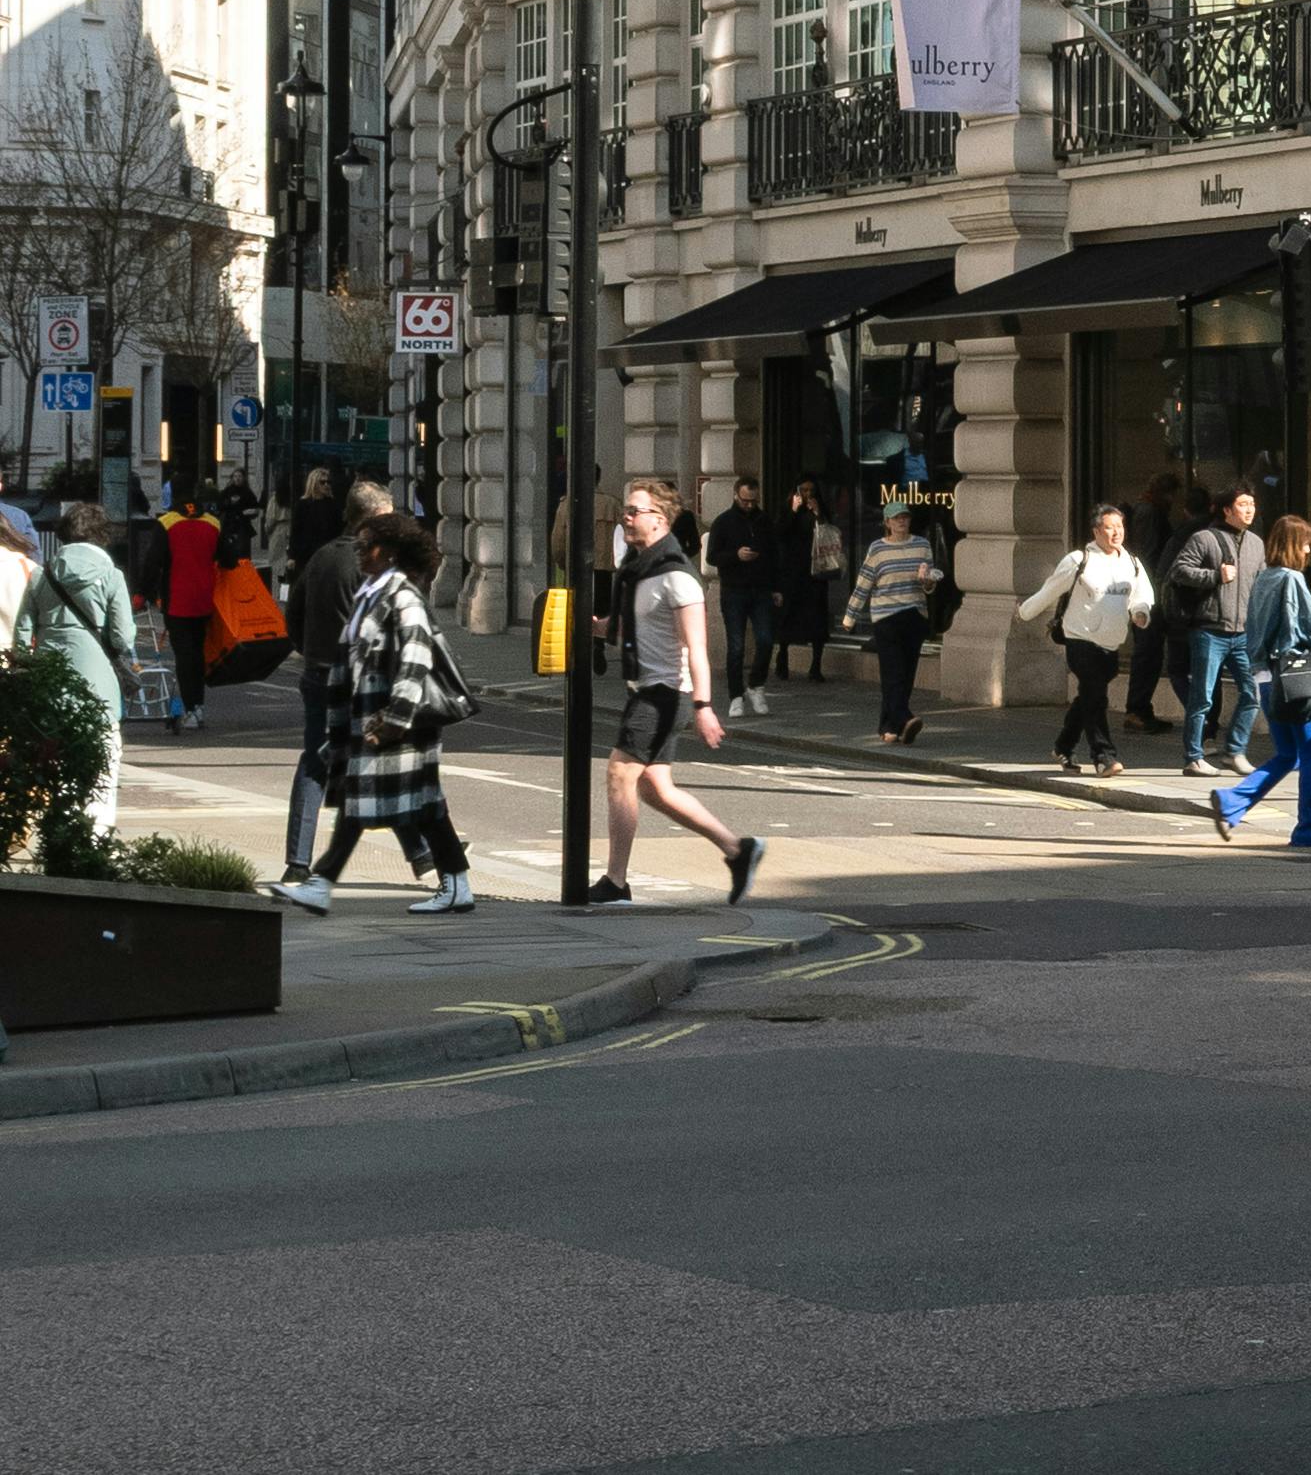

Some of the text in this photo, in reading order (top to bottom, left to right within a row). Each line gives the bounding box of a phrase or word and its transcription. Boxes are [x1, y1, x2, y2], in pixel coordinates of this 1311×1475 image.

[910, 44, 996, 83] ulberry
[1200, 173, 1244, 210] Mulberry
[48, 310, 78, 319] ZONE
[401, 340, 453, 350] NORTH
[879, 481, 956, 510] Mulberry
